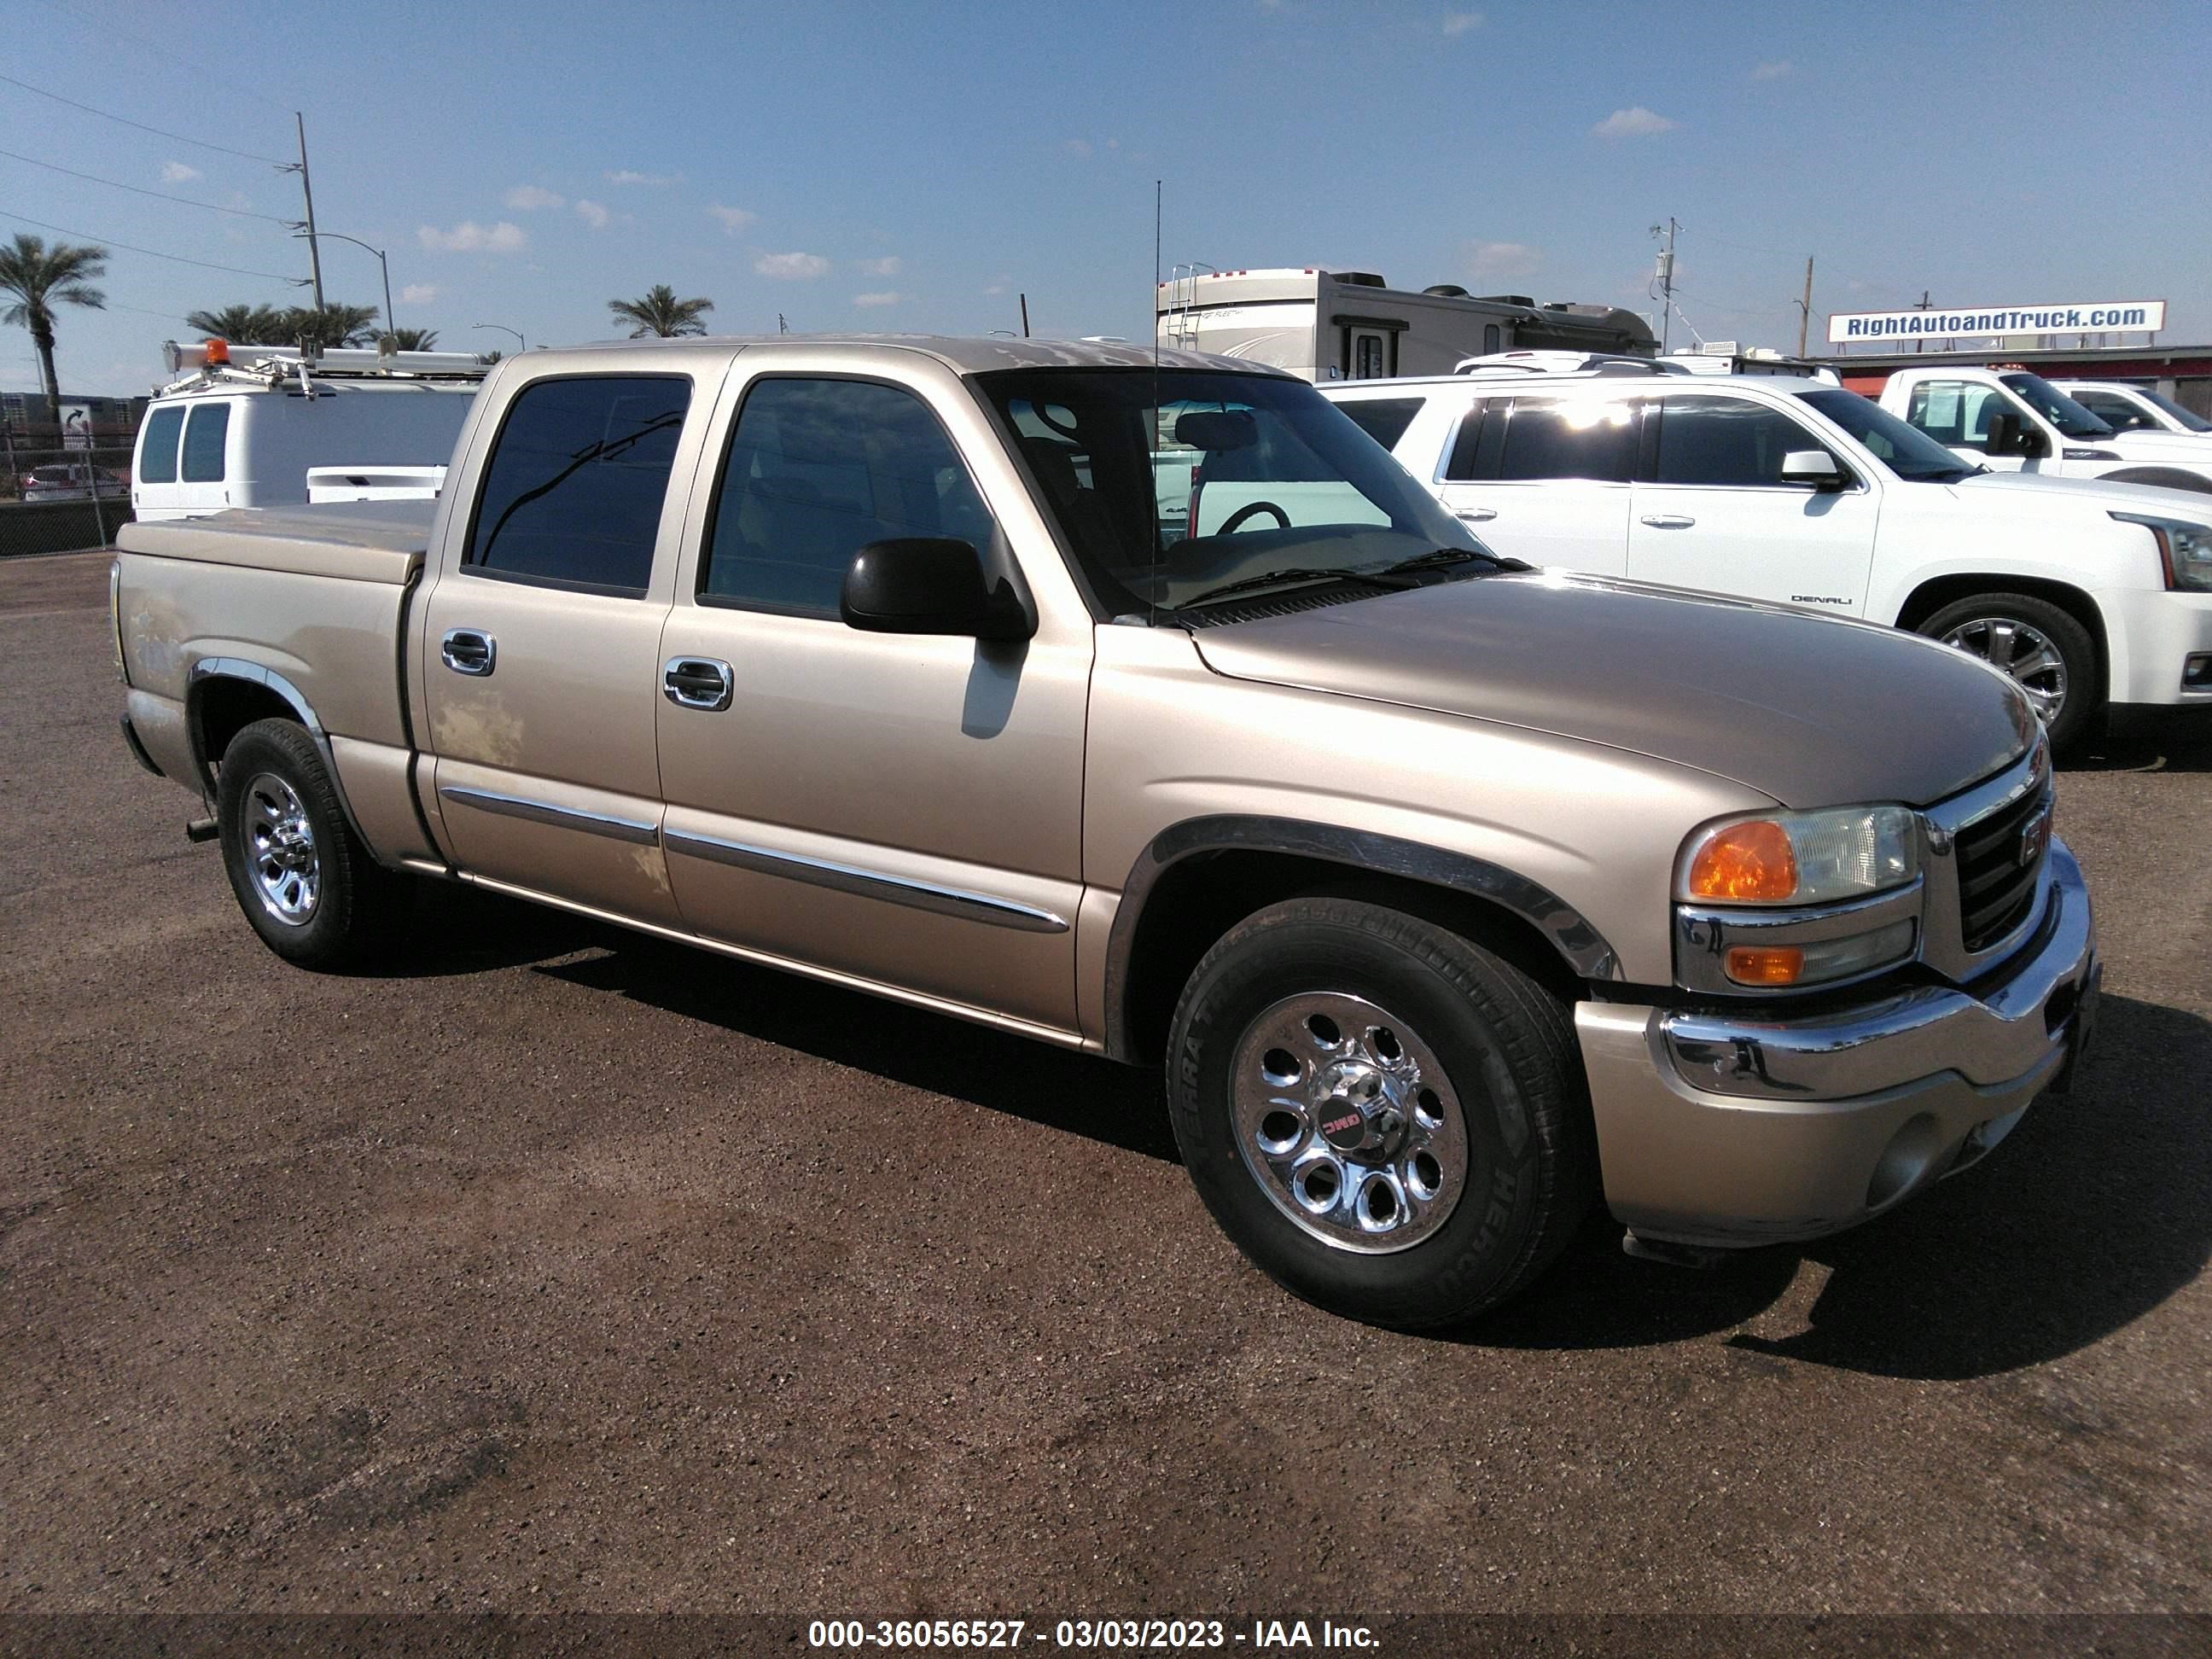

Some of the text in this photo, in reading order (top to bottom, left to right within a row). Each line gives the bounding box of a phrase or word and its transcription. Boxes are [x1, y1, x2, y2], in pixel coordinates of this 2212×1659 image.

[1847, 308, 2146, 336] RightAutoandTruck.com
[1791, 595, 1853, 605] DENALI
[1322, 1113, 1361, 1135] GMC
